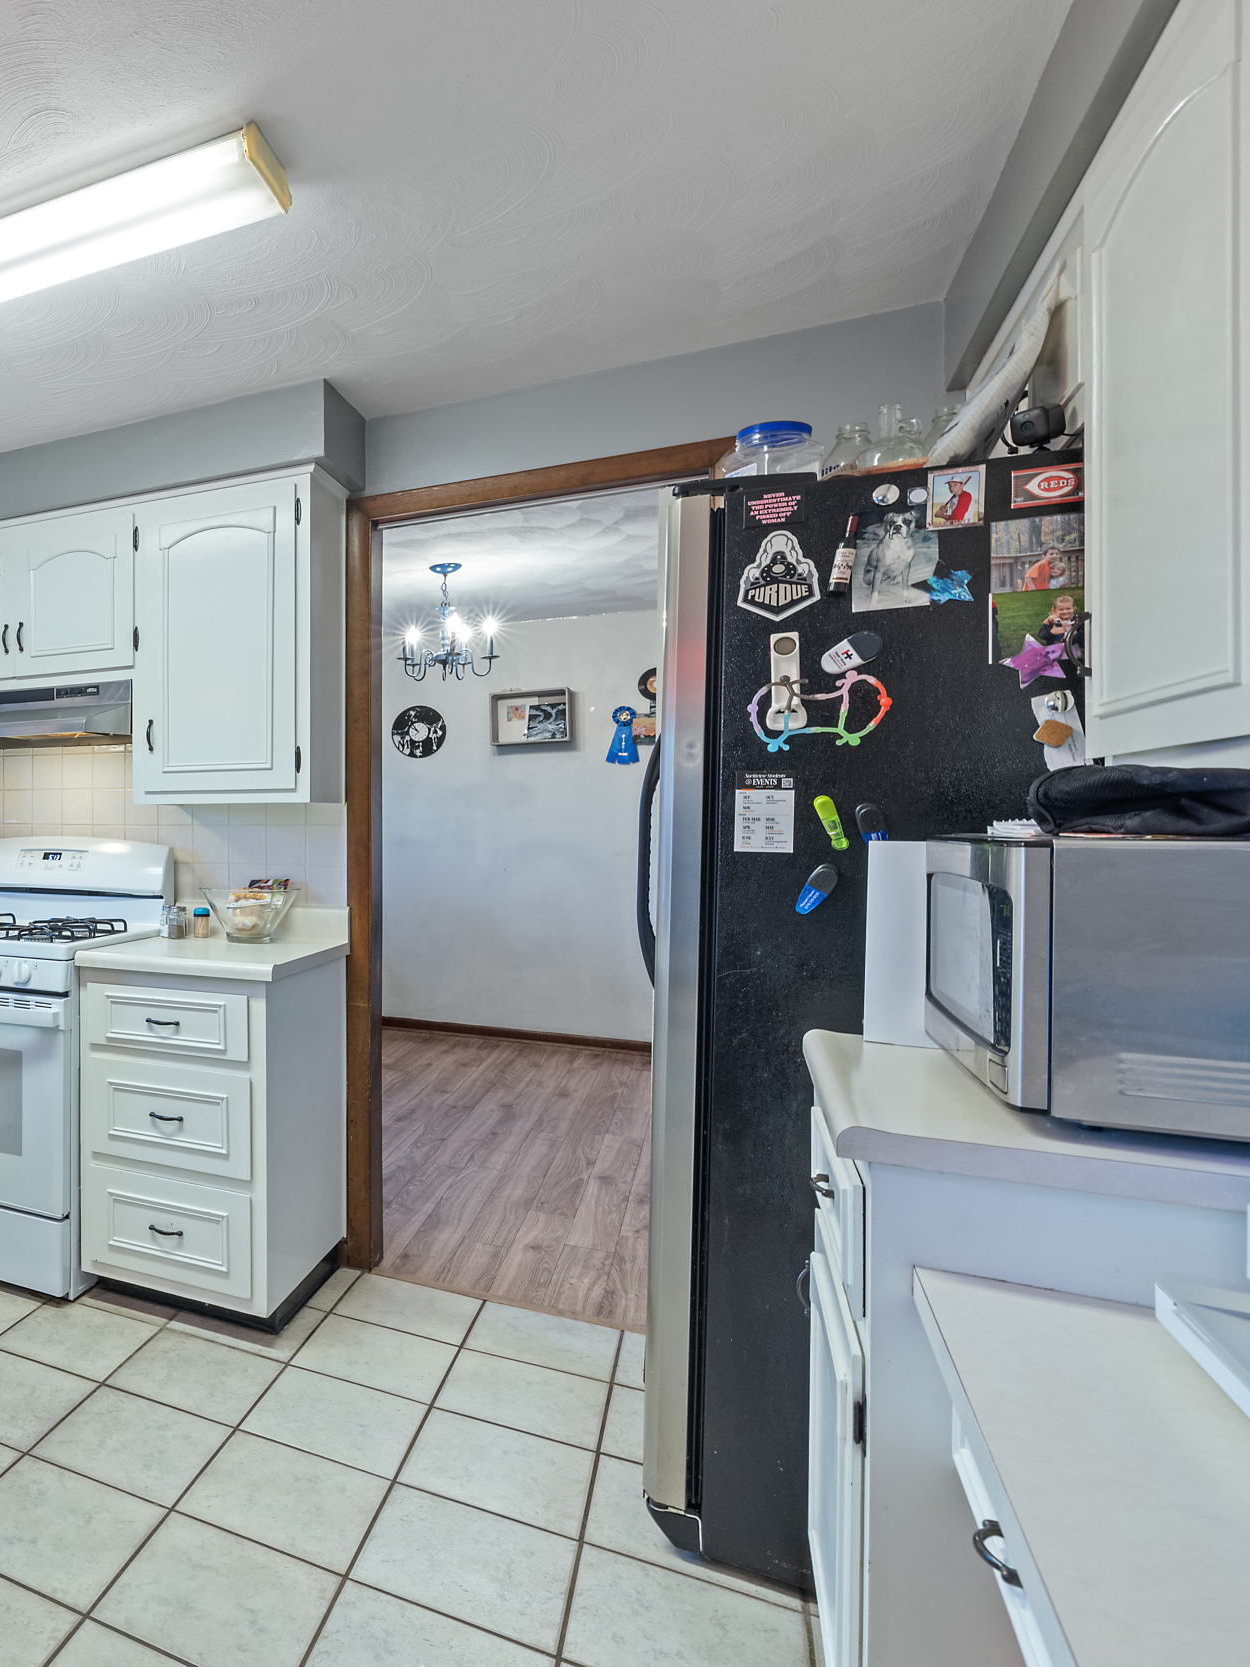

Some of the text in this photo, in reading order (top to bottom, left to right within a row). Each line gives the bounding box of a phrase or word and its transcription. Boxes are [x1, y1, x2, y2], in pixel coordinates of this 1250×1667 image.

[1040, 478, 1075, 489] REDS
[747, 495, 801, 506] UNDERESTIMATE
[760, 506, 798, 515] EXTREMELY
[748, 583, 809, 607] PURDUE
[752, 778, 778, 786] EVENTS
